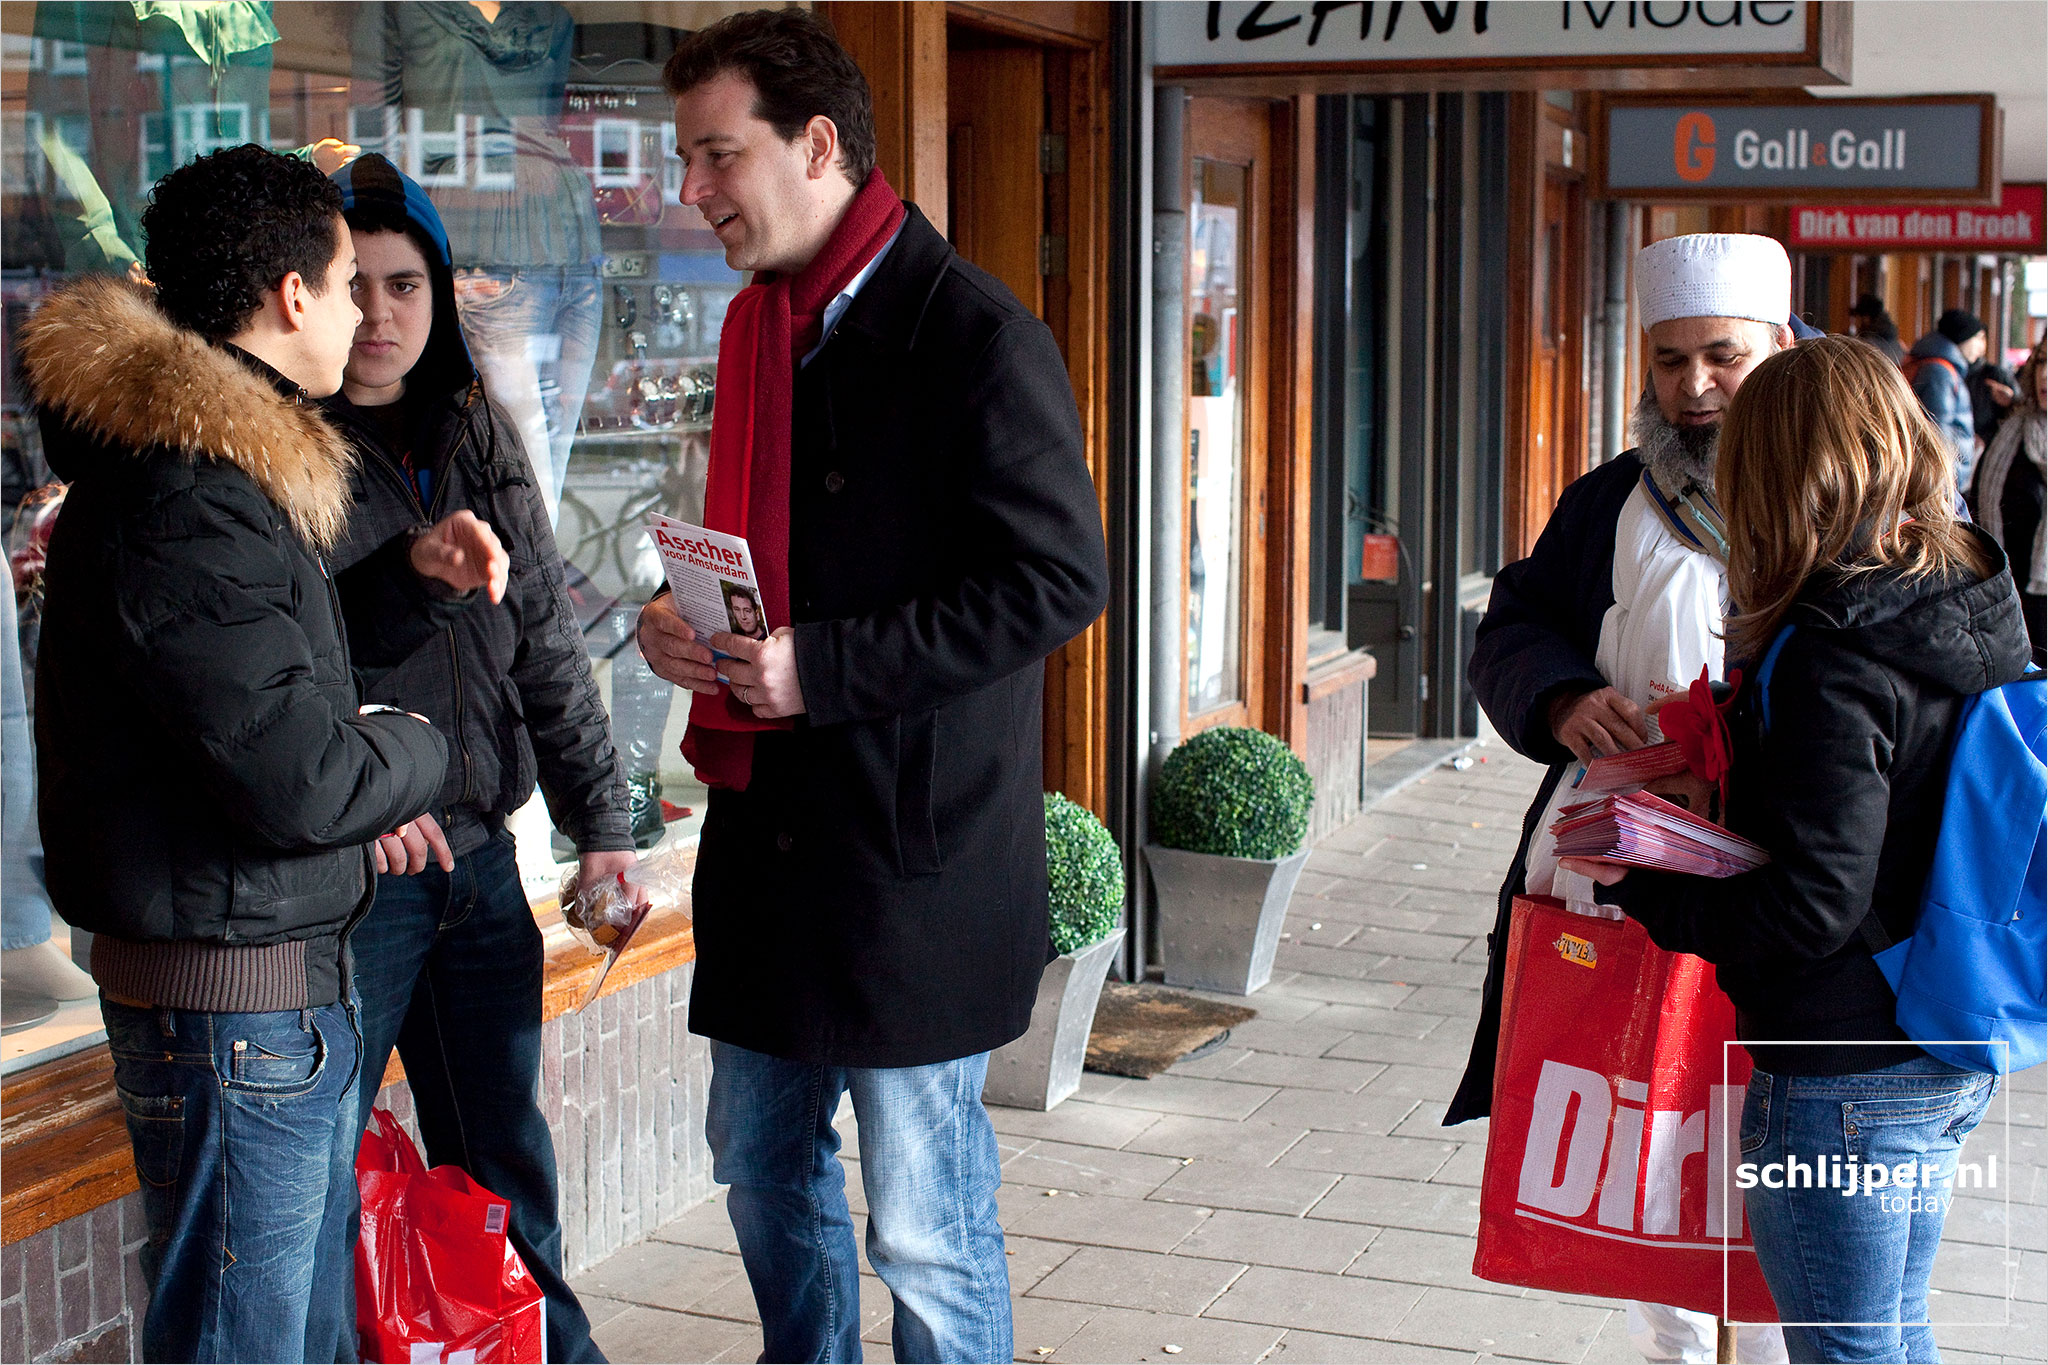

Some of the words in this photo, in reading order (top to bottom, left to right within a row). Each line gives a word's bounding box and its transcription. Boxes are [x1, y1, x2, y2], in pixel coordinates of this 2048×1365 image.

[1674, 111, 1716, 182] G
[1800, 209, 1850, 239] Dirk
[1854, 213, 1899, 239] van
[1903, 209, 1951, 239] den
[1957, 209, 2032, 240] Broek
[655, 529, 743, 567] Asscher
[662, 548, 686, 561] voor
[688, 553, 749, 581] Amsterdam
